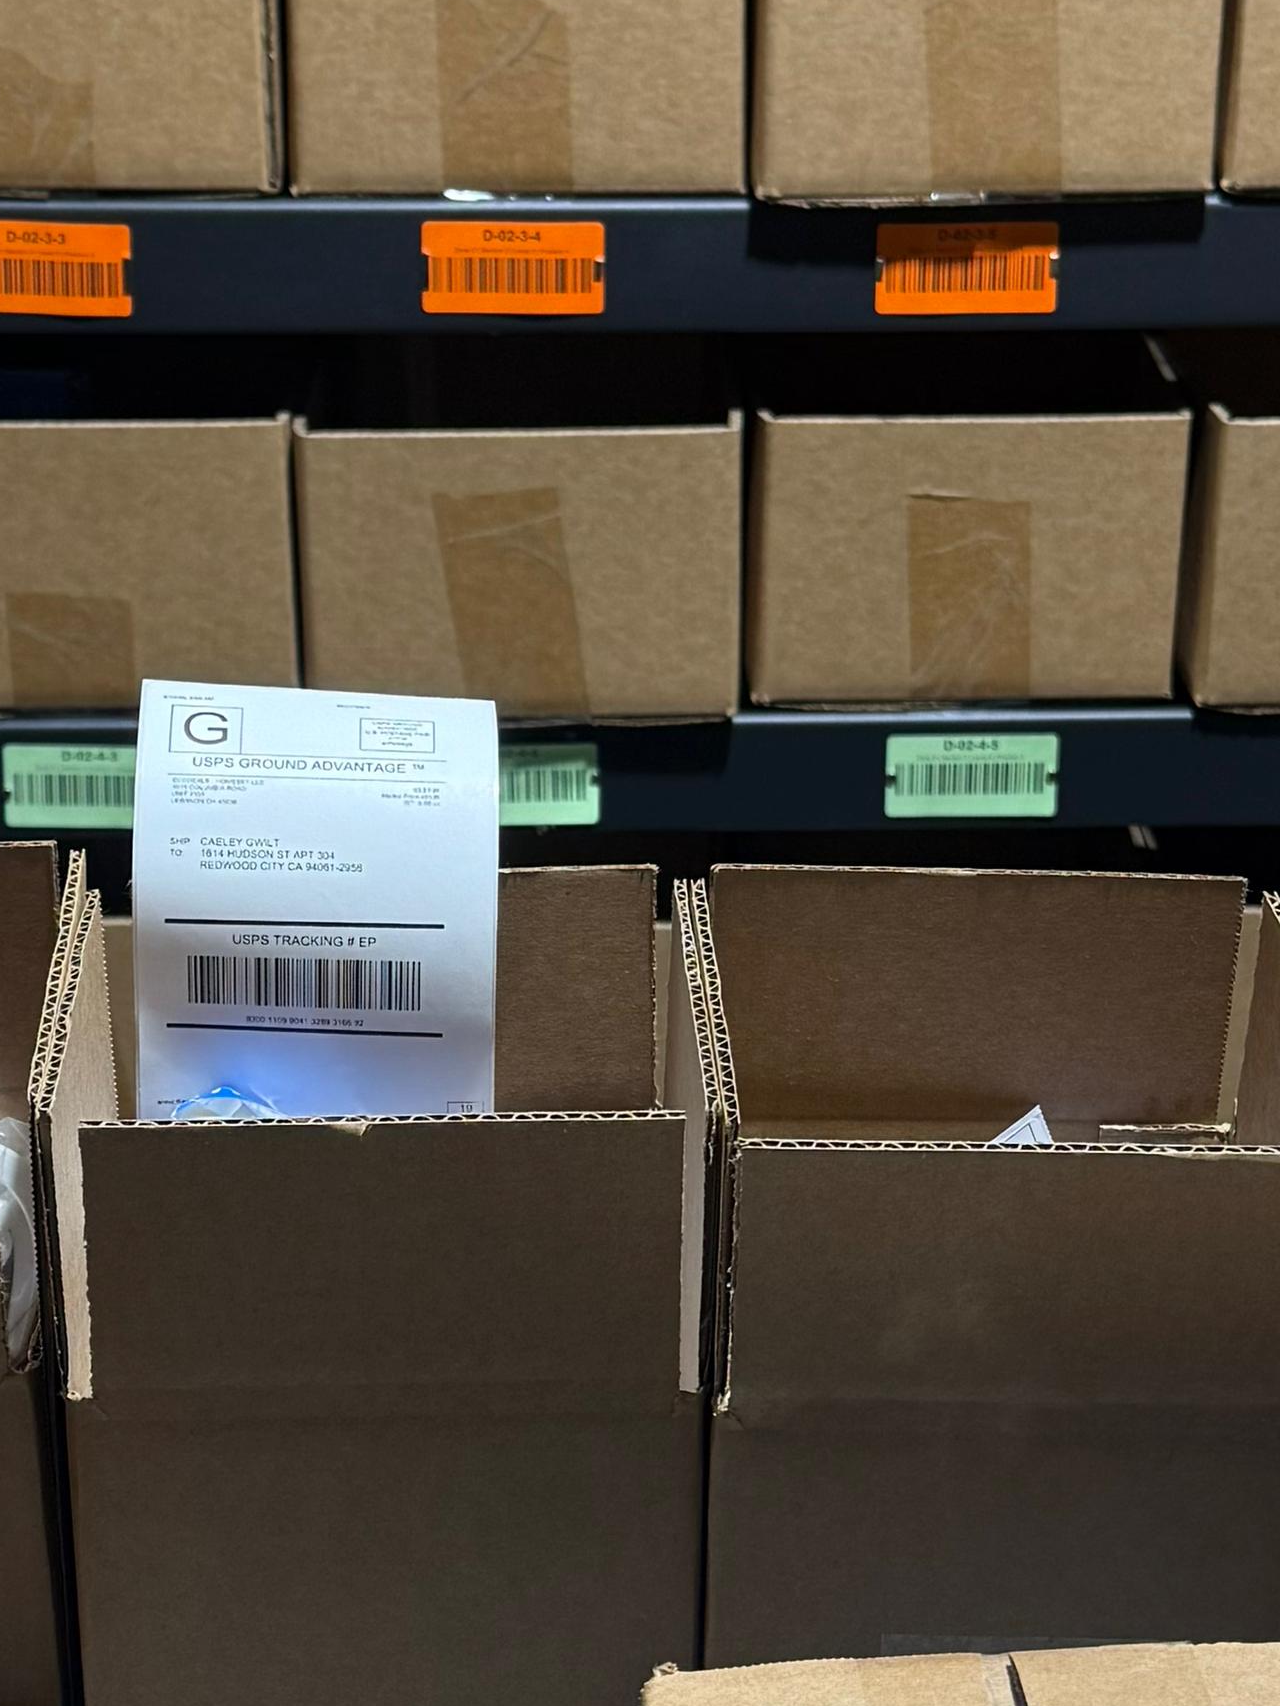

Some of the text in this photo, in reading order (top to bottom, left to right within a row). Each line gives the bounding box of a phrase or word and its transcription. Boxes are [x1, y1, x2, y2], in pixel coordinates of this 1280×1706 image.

[6, 231, 66, 245] D-02-3-3
[483, 229, 541, 244] D-02-3-4
[184, 711, 228, 745] G
[61, 750, 118, 763] D-02-4-3
[192, 756, 407, 775] USPS GROUND ADVANTAGE
[170, 848, 183, 857] TO
[227, 849, 274, 860] HUDSON
[277, 850, 290, 860] ST
[293, 850, 314, 861] APT
[200, 860, 258, 871] REDWOOD
[260, 861, 285, 872] CITY
[287, 861, 303, 873] CA
[232, 933, 377, 949] USPS TRACKING # EP
